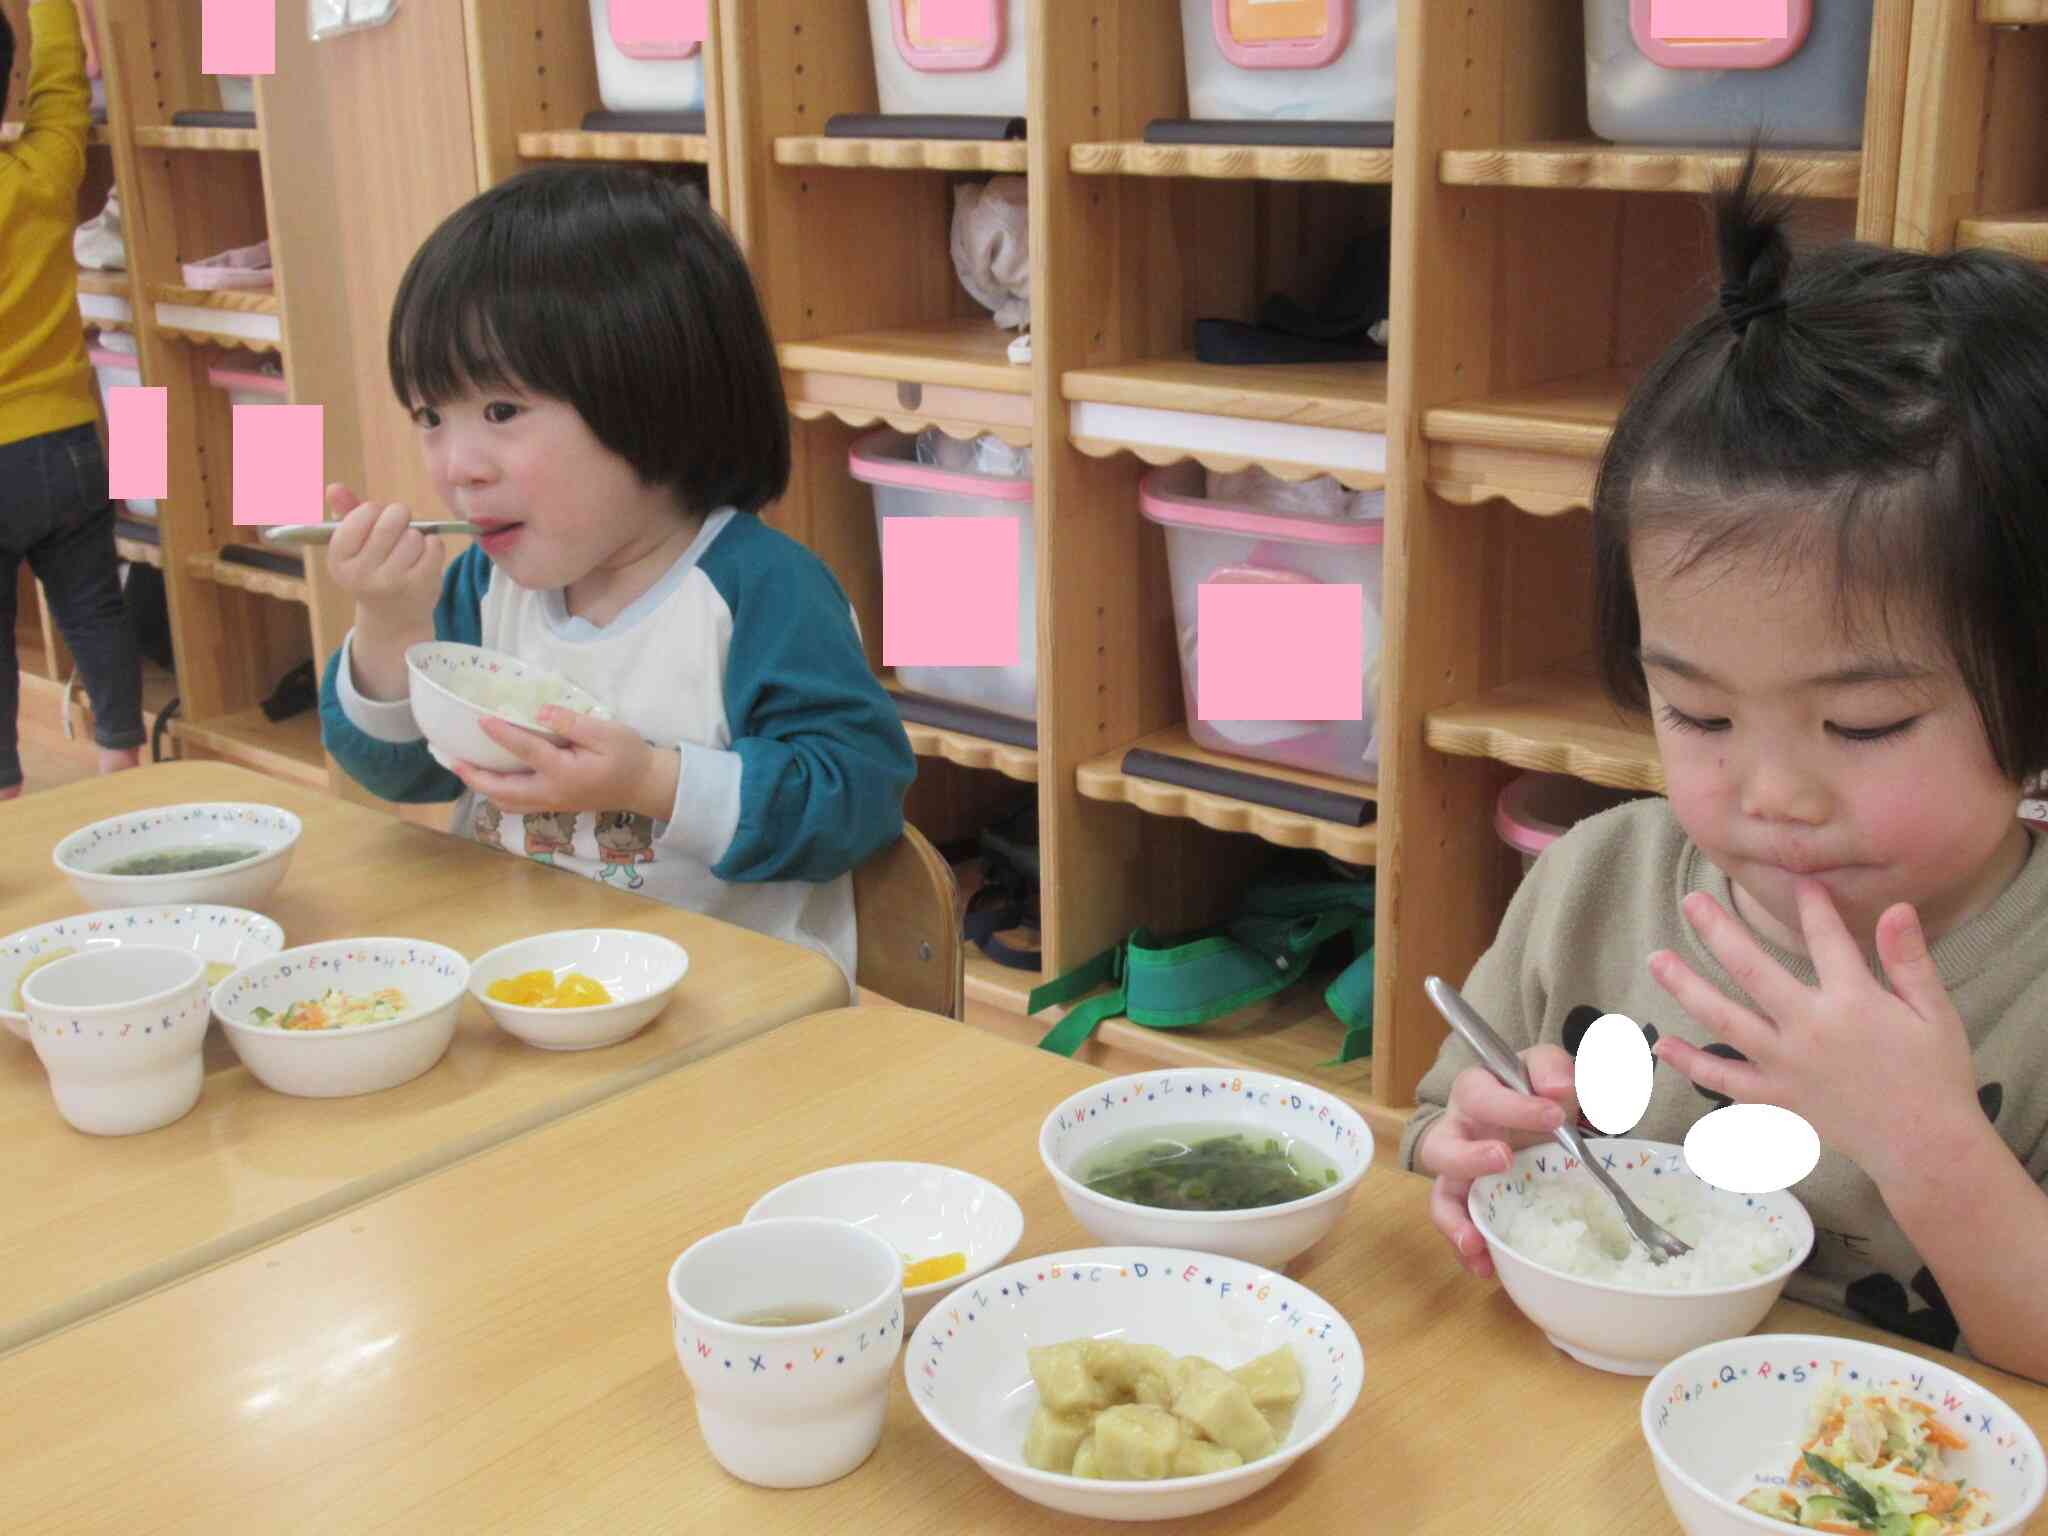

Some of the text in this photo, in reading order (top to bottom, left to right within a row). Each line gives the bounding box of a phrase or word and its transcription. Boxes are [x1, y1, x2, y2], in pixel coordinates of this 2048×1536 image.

[1074, 1107, 1086, 1121] W
[1101, 1092, 1114, 1109] X
[1160, 1078, 1173, 1094] Z
[1201, 1082, 1213, 1097] A
[1231, 1077, 1242, 1092] B
[1258, 1092, 1271, 1105] C
[1291, 1095, 1302, 1109] D
[1318, 1105, 1329, 1121] E
[1535, 1156, 1547, 1174] V
[1600, 1153, 1617, 1171] X
[1639, 1152, 1650, 1167] Y
[1666, 1154, 1681, 1173] Z
[931, 1335, 944, 1352] X
[1015, 1280, 1029, 1296] A
[1089, 1266, 1103, 1282] C
[1134, 1263, 1149, 1278] D
[1182, 1263, 1199, 1282] E
[1219, 1281, 1233, 1299] F
[696, 1338, 713, 1358] W
[750, 1353, 767, 1373] X
[812, 1345, 826, 1363] Y
[1719, 1364, 1737, 1384] Q
[1757, 1360, 1772, 1379] R
[1792, 1365, 1807, 1383] S
[1830, 1359, 1845, 1377] T
[1943, 1390, 1963, 1411] W
[1979, 1415, 1993, 1433] X
